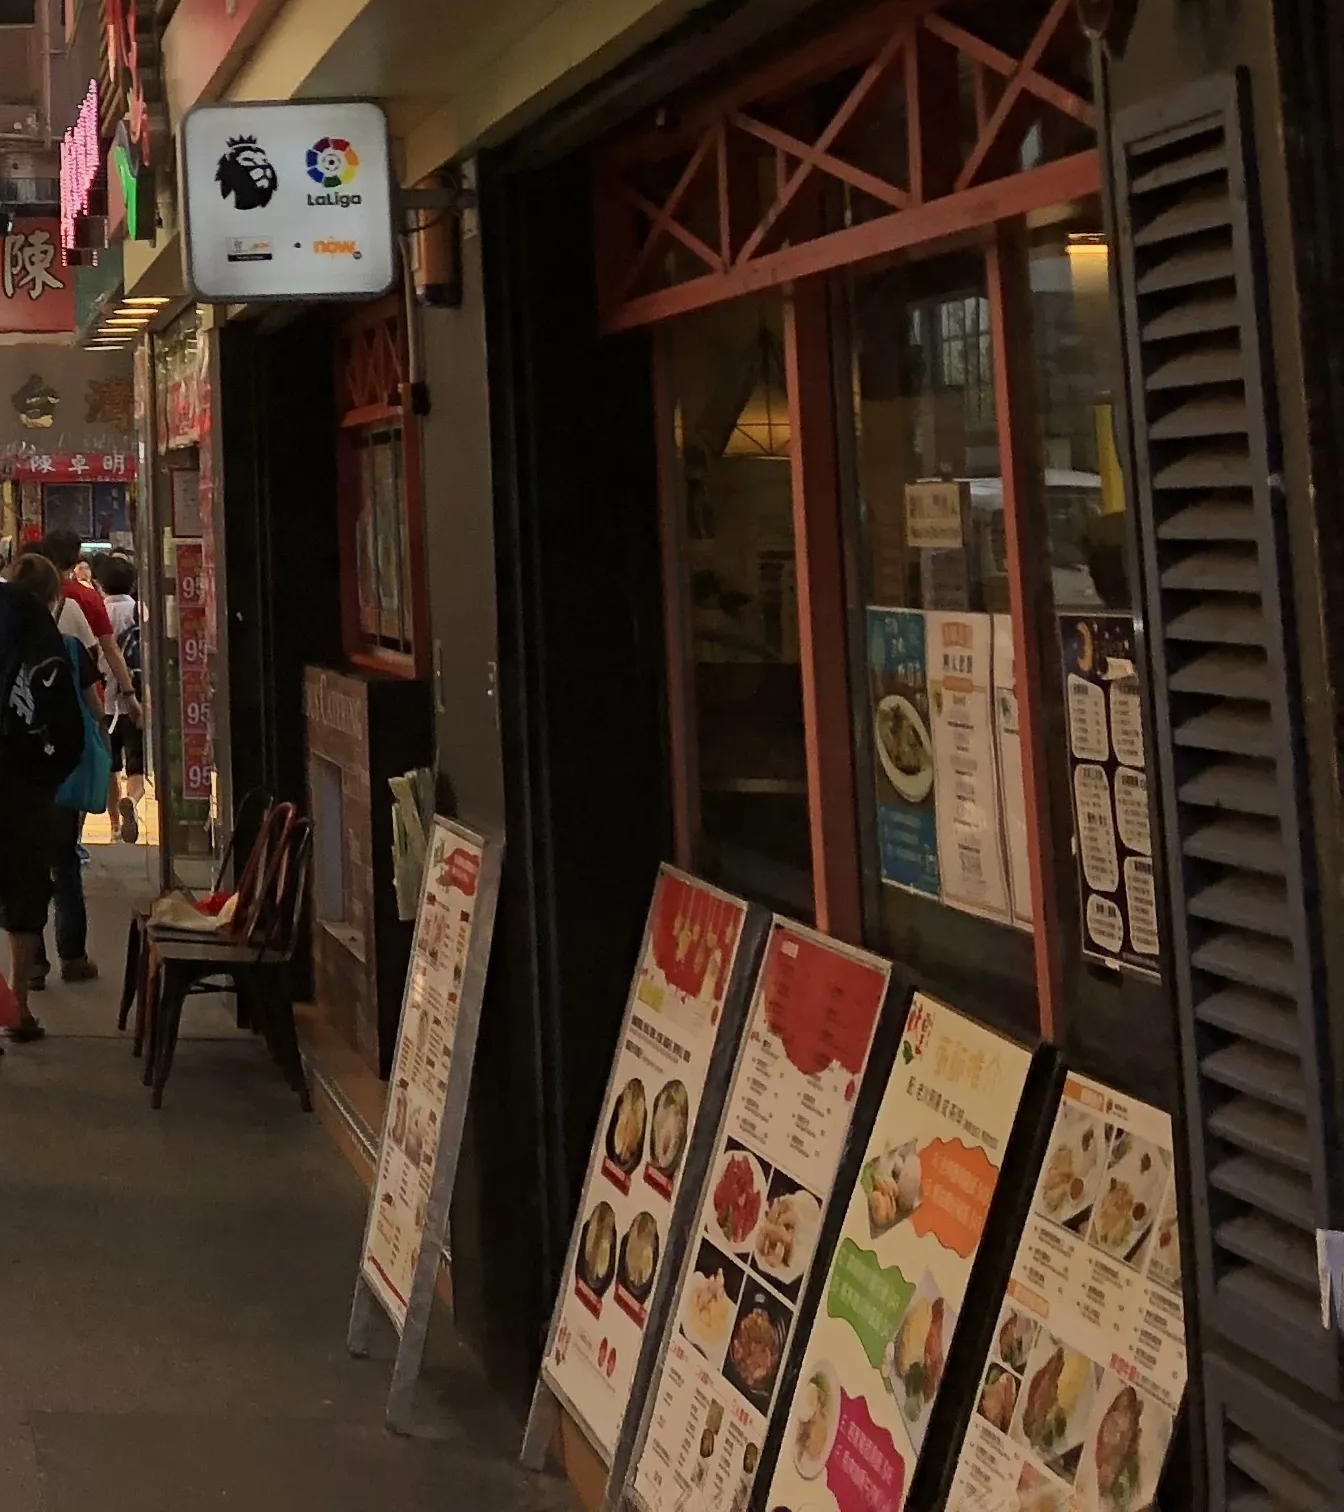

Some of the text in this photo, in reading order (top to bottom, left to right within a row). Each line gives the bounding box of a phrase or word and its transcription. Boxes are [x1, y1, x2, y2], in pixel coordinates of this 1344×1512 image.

[306, 191, 363, 208] LaLiga
[2, 228, 65, 301] 陳
[184, 638, 208, 662] 95
[186, 702, 211, 725] 95
[188, 765, 213, 788] 95
